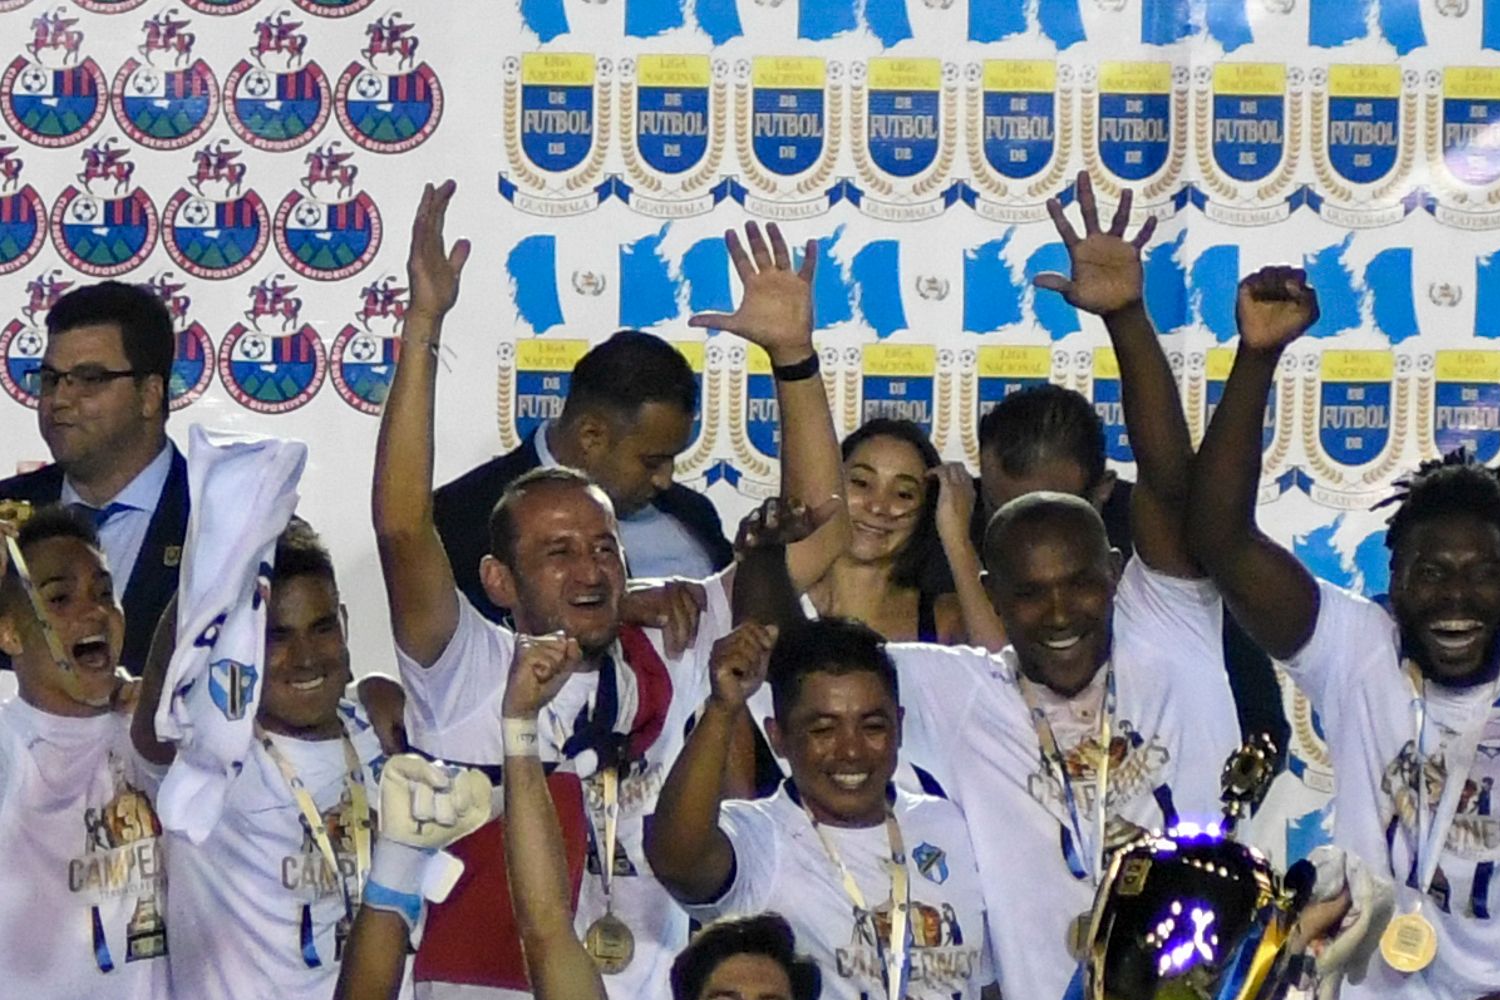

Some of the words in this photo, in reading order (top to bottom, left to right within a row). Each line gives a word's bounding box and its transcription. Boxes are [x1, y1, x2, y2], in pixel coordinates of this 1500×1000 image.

[524, 110, 592, 134] FUTBOL
[639, 112, 707, 136] FUTBOL
[754, 113, 822, 137] FUTBOL
[869, 115, 937, 139] FUTBOL
[984, 117, 1052, 141] FUTBOL
[1100, 118, 1167, 142] FUTBOL
[1215, 120, 1282, 144] FUTBOL
[1330, 122, 1397, 146] FUTBOL
[518, 200, 590, 216] GUATEMALA
[634, 202, 705, 218] GUATEMALA
[518, 395, 565, 418] FUTB
[748, 398, 780, 422] FUT
[1095, 403, 1126, 426] FUT
[1322, 406, 1389, 428] FUTBOL
